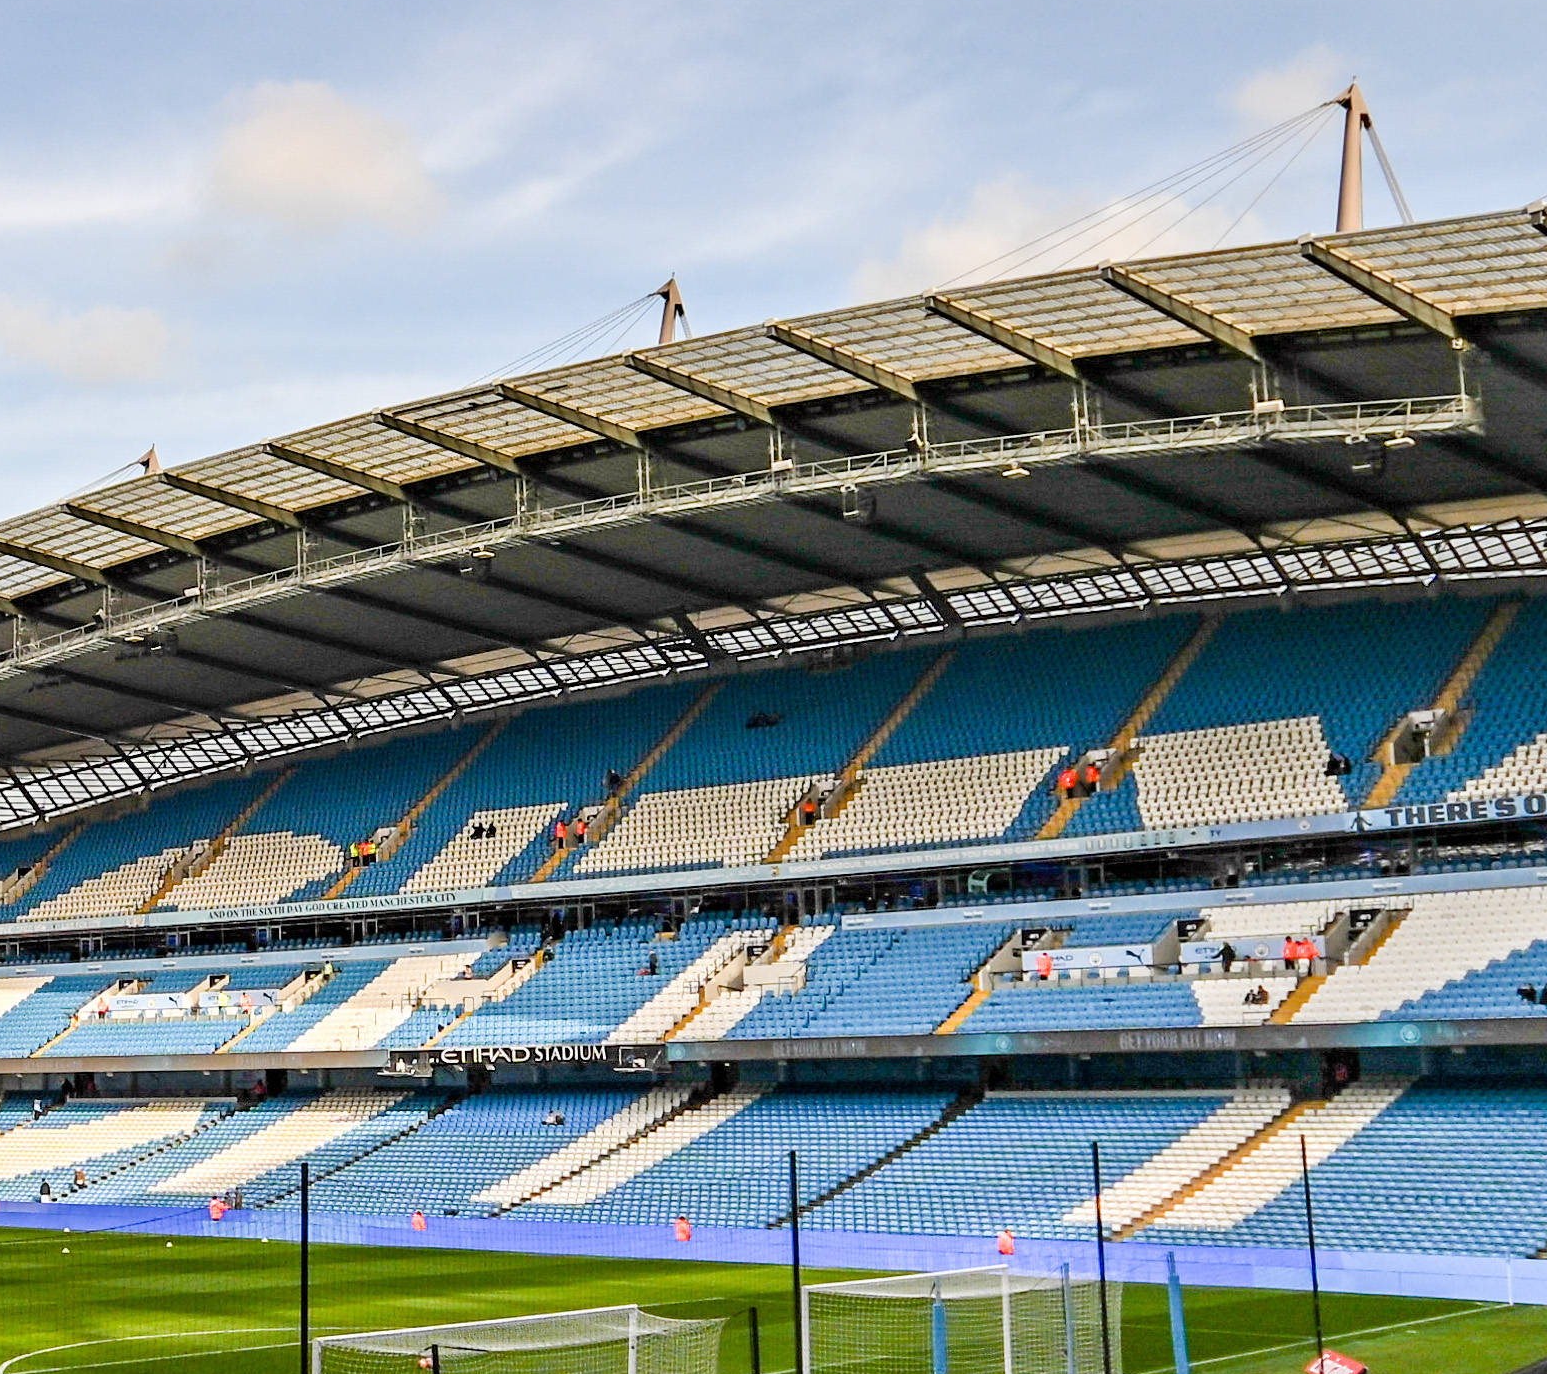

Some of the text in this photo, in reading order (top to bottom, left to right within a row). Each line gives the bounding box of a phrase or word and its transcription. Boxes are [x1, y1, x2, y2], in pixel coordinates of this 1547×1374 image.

[1385, 797, 1517, 825] THERE'S
[209, 892, 456, 920] AND ON THE SIXTH DAY GOD CREATED MANCHESTER CITY
[440, 1044, 607, 1065] ETIHAD STADIUM
